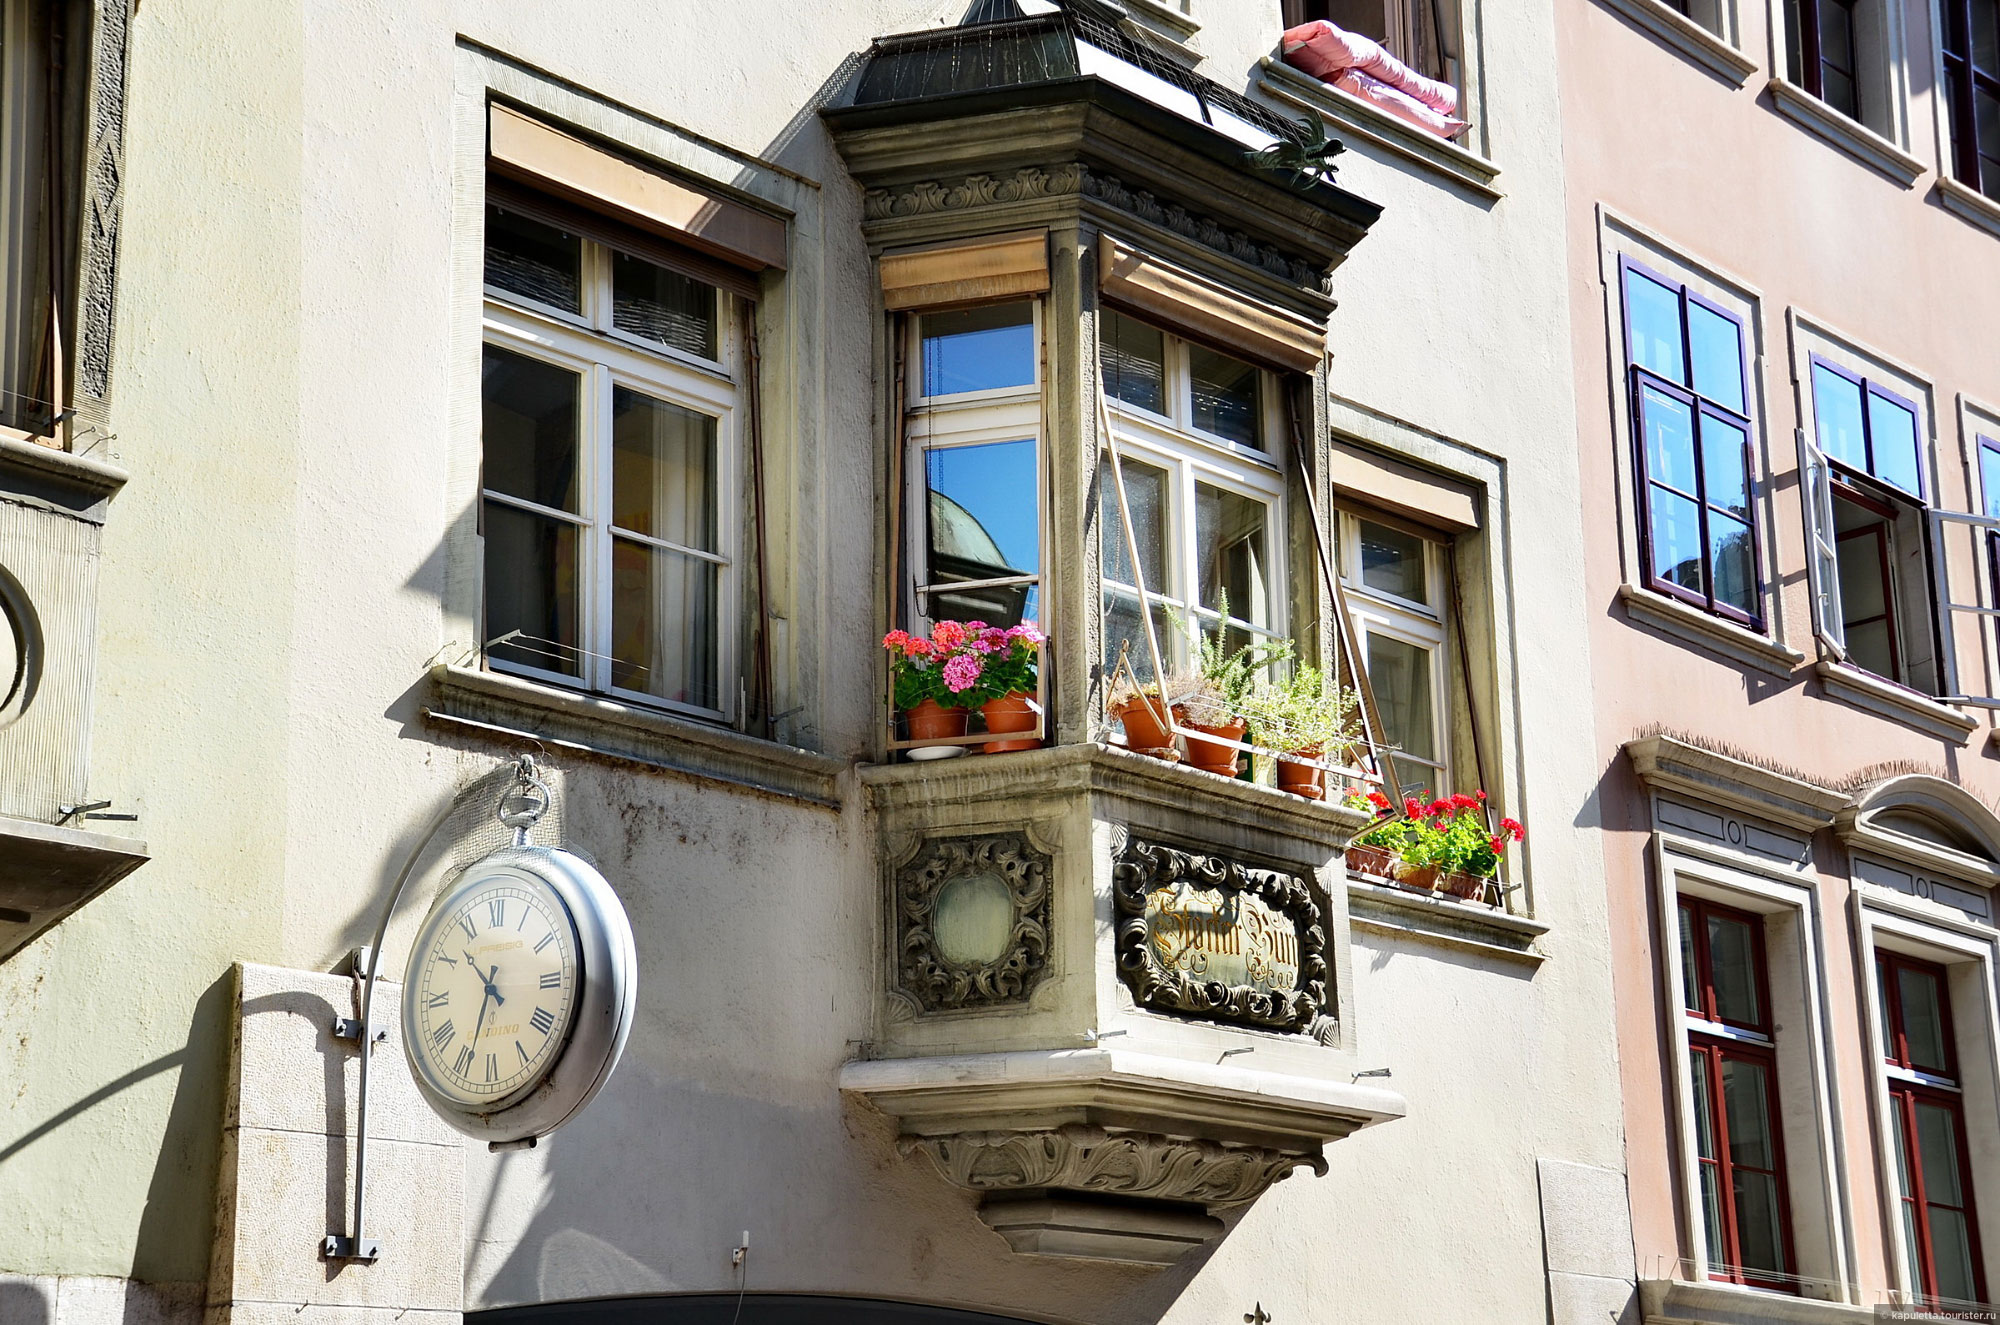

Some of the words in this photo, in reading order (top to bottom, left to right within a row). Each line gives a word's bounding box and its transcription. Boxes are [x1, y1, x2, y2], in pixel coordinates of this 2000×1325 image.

[488, 899, 505, 930] XII
[458, 913, 478, 944] XI
[533, 931, 555, 955] II
[438, 949, 458, 971] X
[539, 970, 561, 990] III
